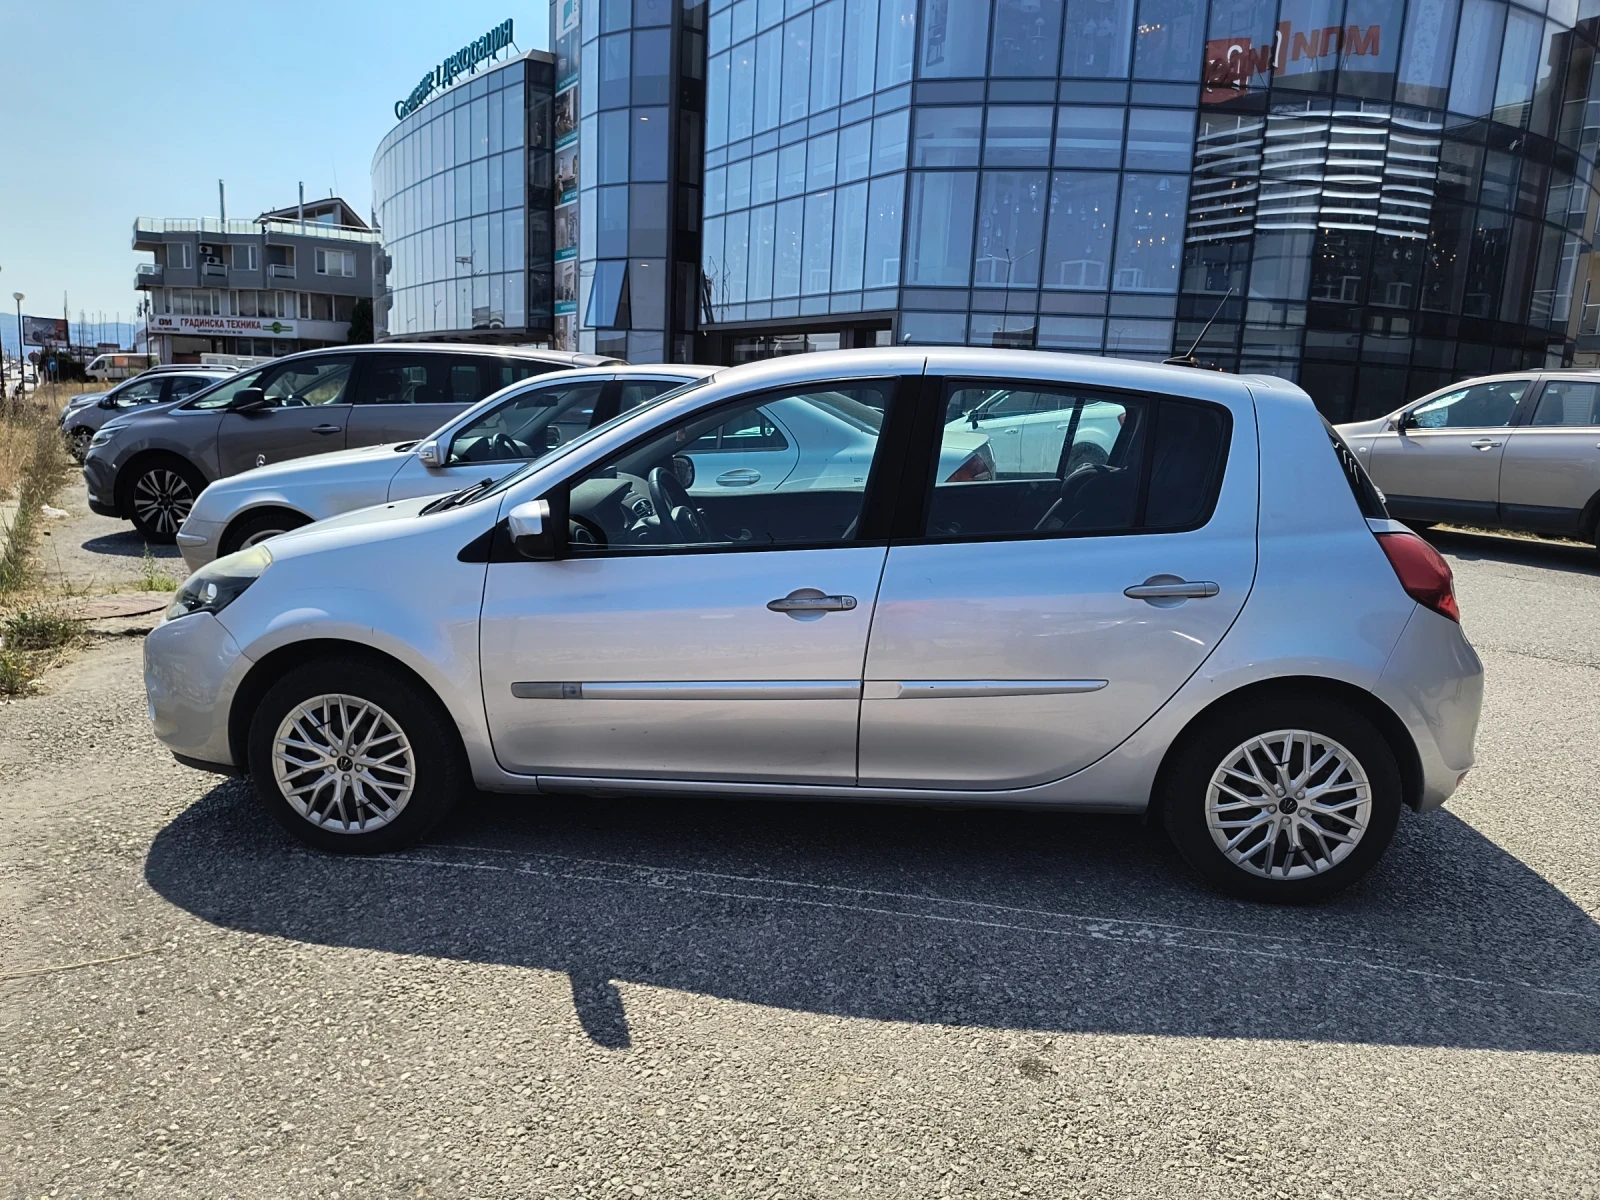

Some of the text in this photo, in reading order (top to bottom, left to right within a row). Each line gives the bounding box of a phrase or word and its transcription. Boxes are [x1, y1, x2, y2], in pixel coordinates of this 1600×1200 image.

[442, 18, 513, 89] декорация
[180, 318, 262, 330] ГРАДИНСКА ТЕХНИКА
